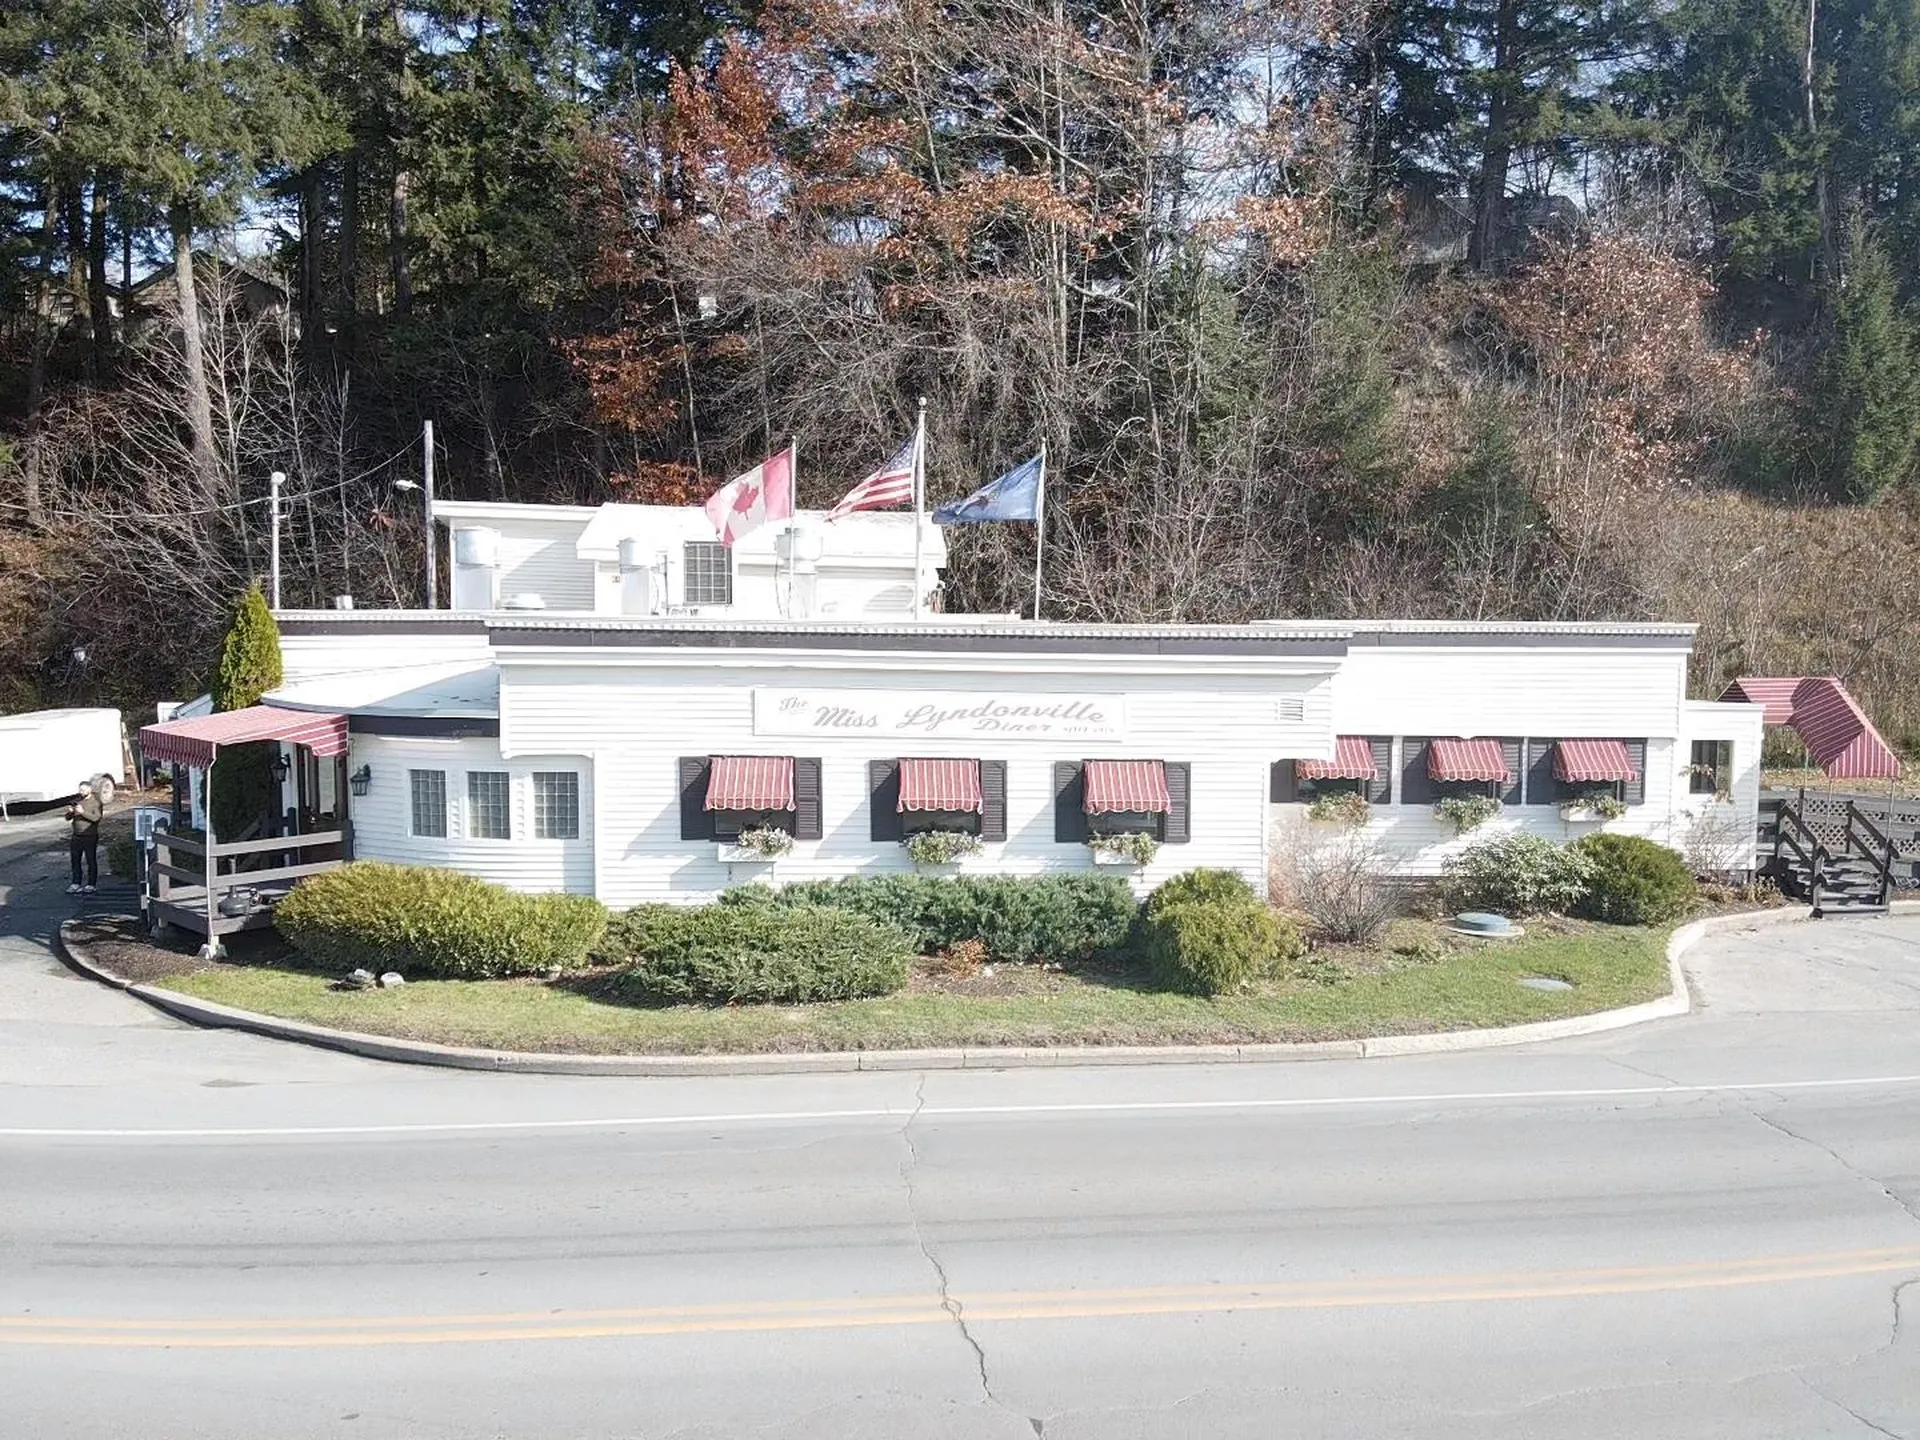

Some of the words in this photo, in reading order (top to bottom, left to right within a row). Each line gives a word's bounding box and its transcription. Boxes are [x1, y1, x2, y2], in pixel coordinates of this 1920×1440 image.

[779, 696, 809, 712] The
[813, 706, 878, 728] Miss
[896, 699, 1105, 731] Lyndonville
[973, 718, 1053, 732] Diner
